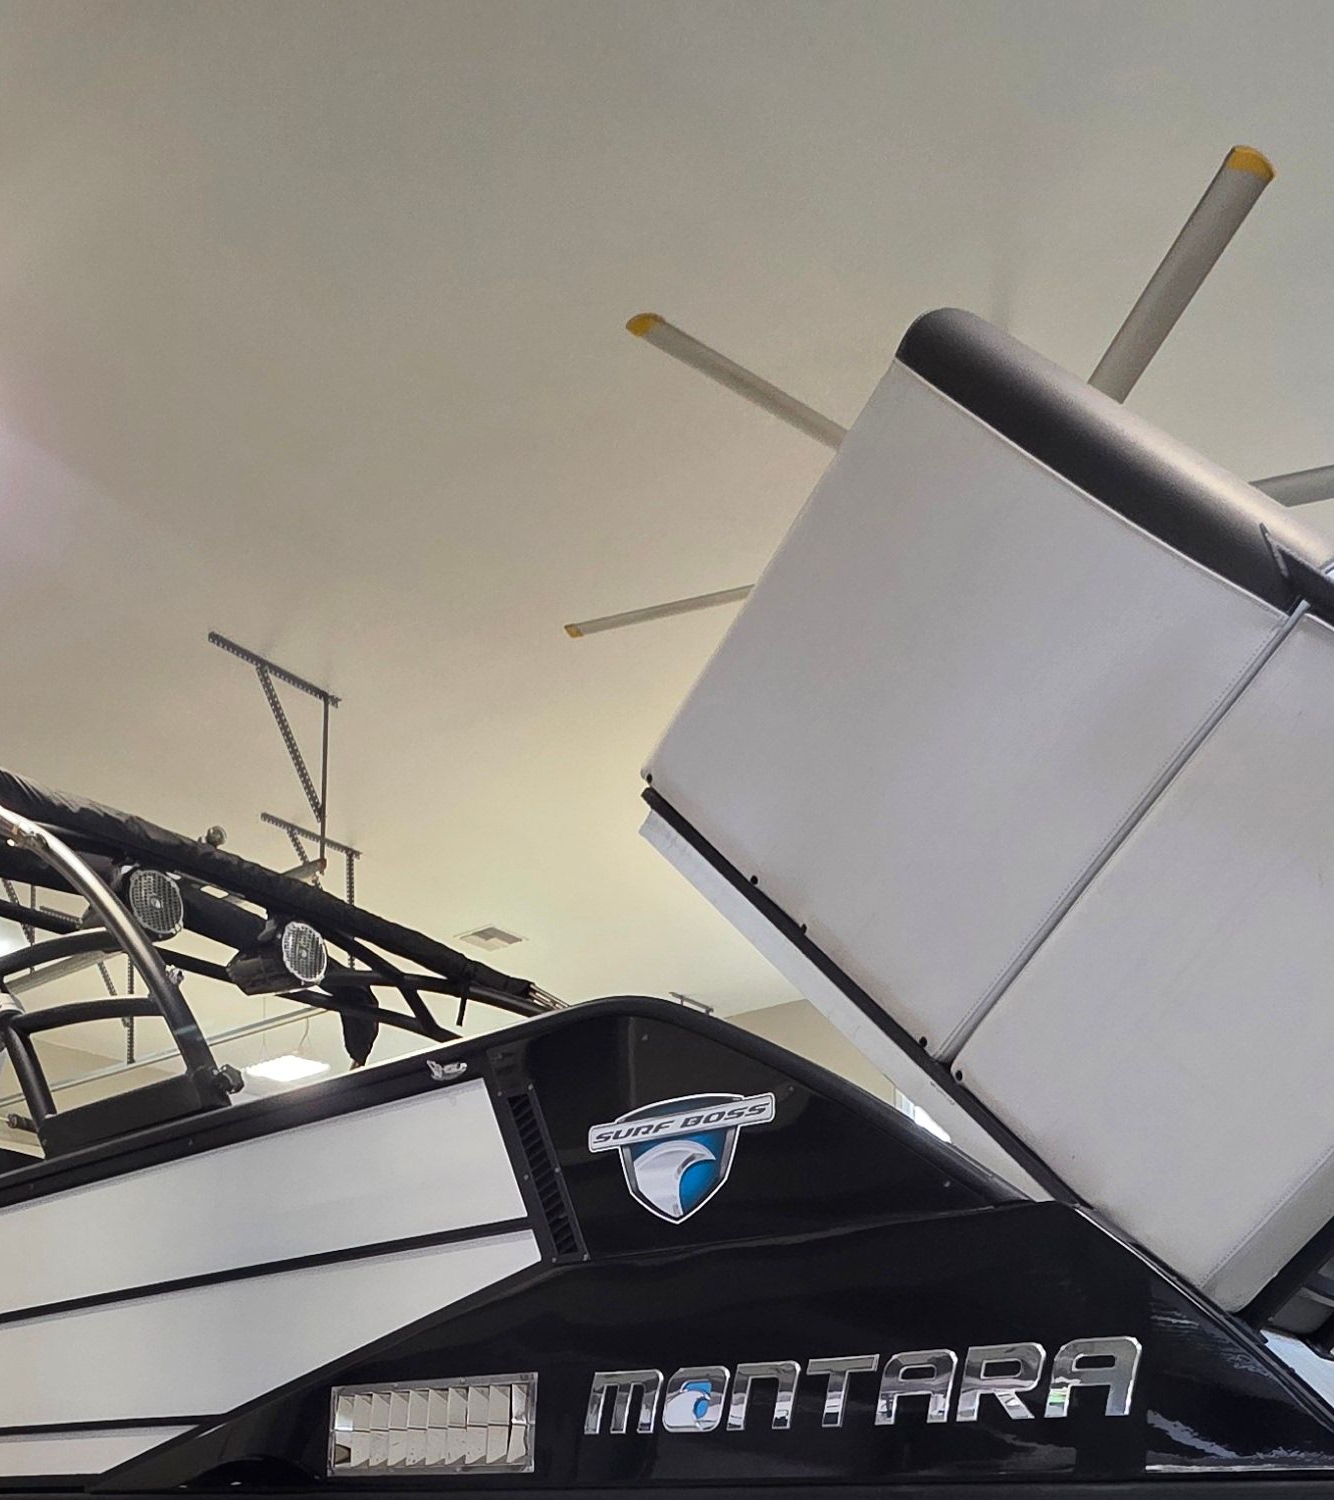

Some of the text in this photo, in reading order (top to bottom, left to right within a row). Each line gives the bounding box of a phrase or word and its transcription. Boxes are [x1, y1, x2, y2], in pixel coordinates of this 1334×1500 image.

[593, 1102, 770, 1144] SURF BOSS
[583, 1336, 1142, 1434] MONTARA
